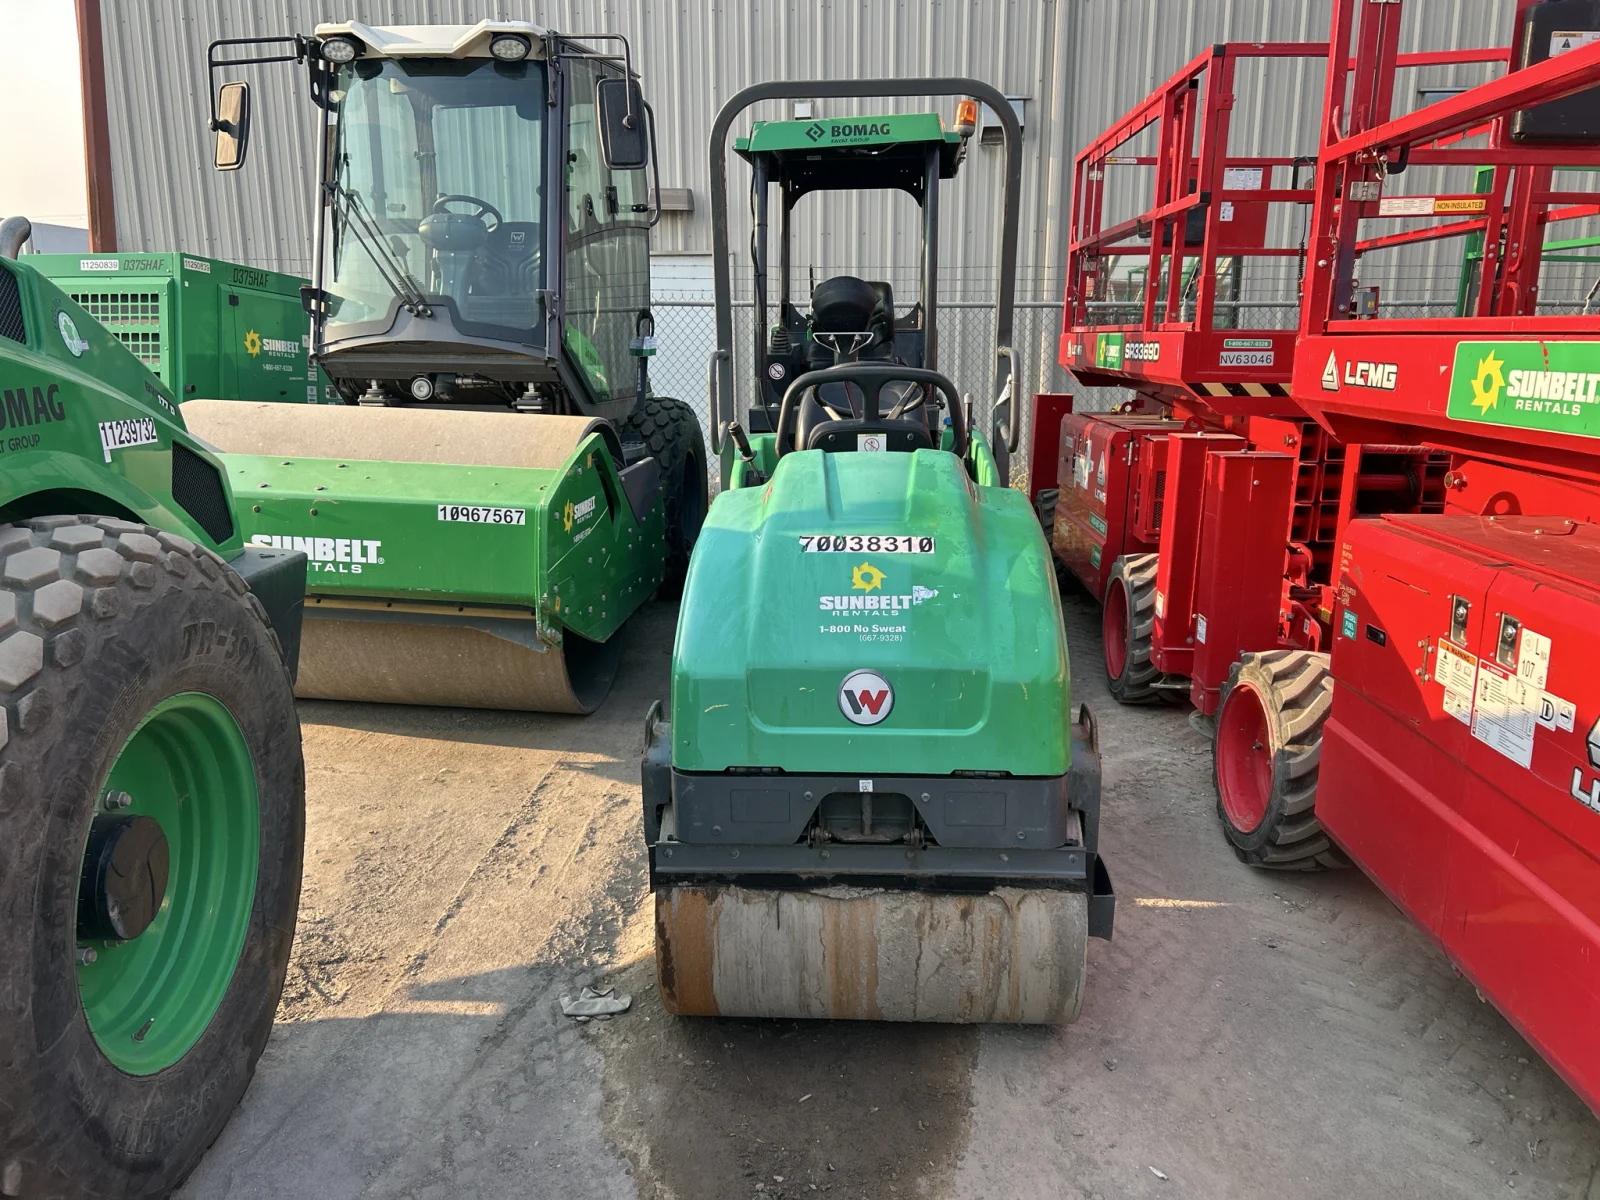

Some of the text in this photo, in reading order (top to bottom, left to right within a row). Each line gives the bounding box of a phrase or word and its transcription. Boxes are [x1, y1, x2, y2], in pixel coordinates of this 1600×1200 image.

[831, 123, 891, 138] BOMAG
[1436, 201, 1484, 210] NON-INSULATED
[81, 261, 118, 270] 11250839
[184, 259, 211, 272] 11250839
[262, 338, 300, 353] SUNBELT
[1124, 341, 1160, 361] SR3369D
[1220, 354, 1273, 365] NV63046
[1506, 370, 1600, 403] SUNBELT
[0, 384, 66, 430] MAG
[1515, 399, 1582, 416] RENTALS
[101, 418, 157, 447] 11239732
[8, 433, 41, 452] GROUP
[440, 505, 525, 525] 10967567
[800, 536, 935, 553] 70038310
[306, 561, 363, 574] TALS
[819, 595, 912, 610] SUNBELT
[819, 624, 907, 633] 1-800 No Sweat
[1522, 659, 1536, 679] 107
